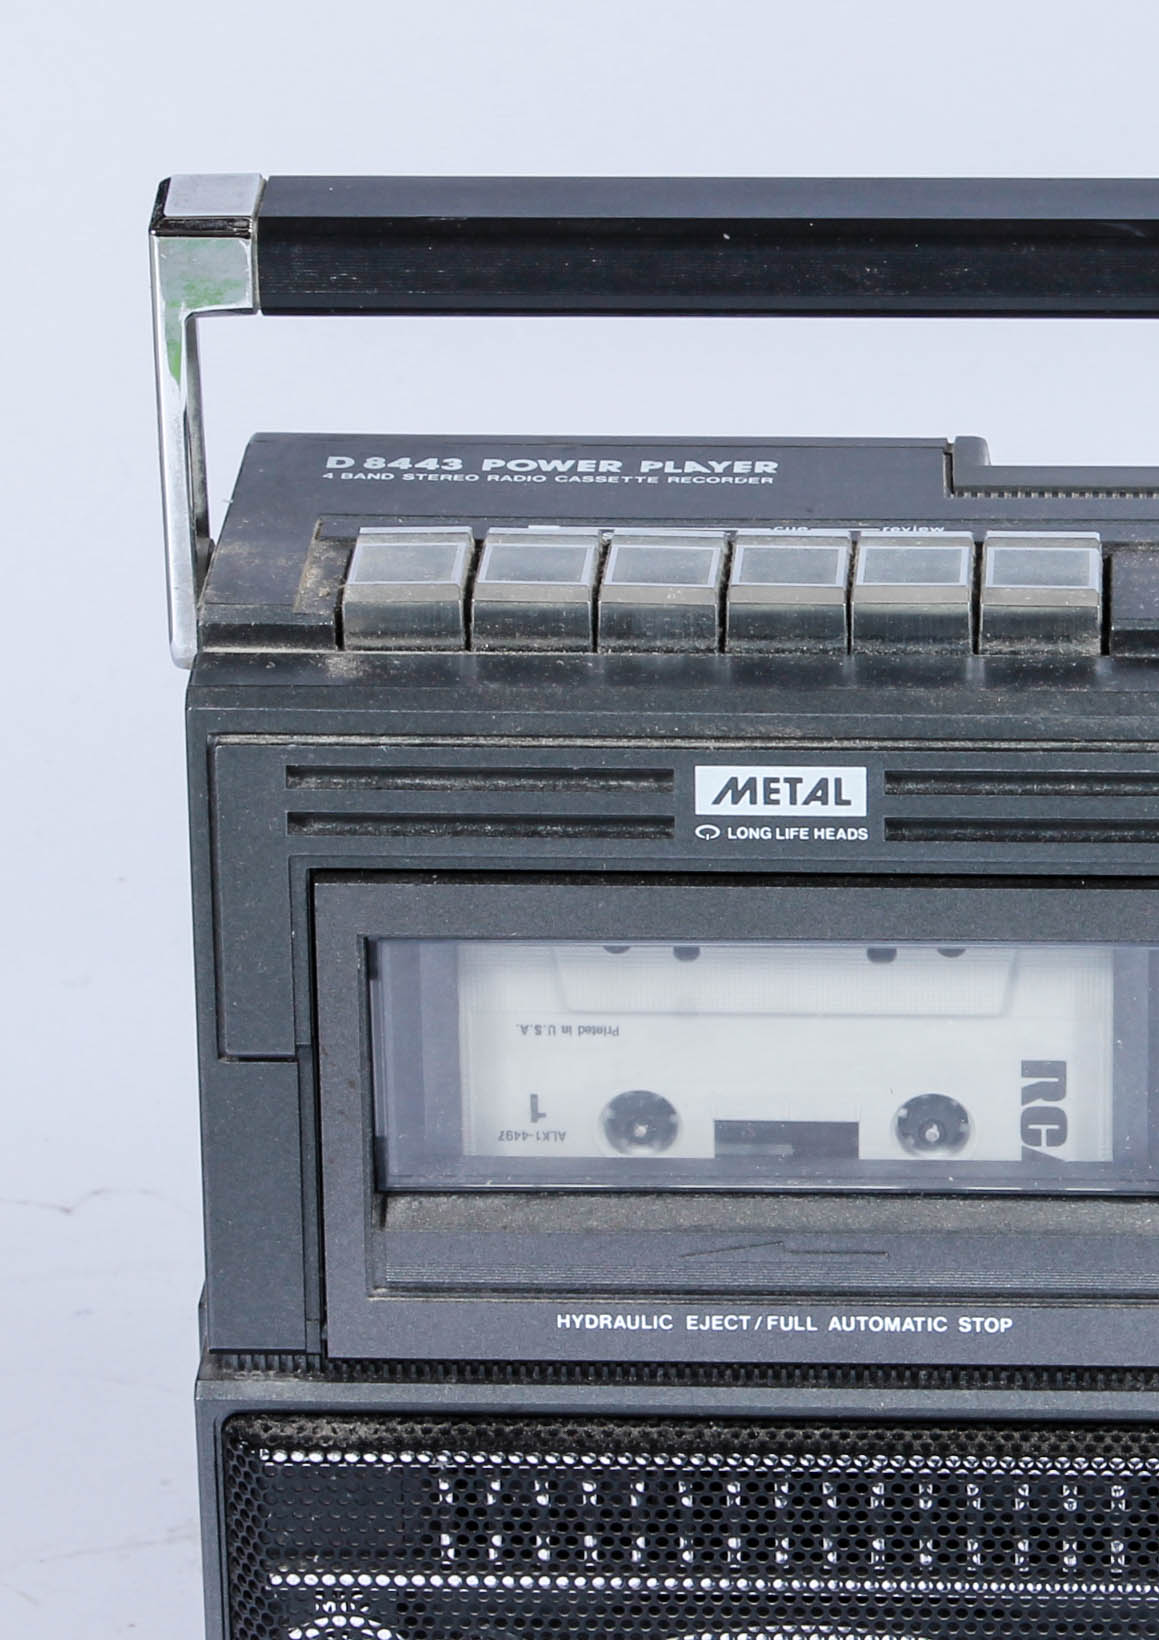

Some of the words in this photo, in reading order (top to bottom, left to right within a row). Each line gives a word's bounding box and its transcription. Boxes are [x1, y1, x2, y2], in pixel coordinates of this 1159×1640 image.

[326, 456, 355, 469] D
[363, 457, 463, 470] 8443
[481, 458, 623, 473] POWER
[640, 460, 779, 473] PLAYER
[322, 472, 334, 480] 4
[341, 472, 395, 481] BAND
[402, 473, 479, 482] STEREO
[487, 474, 547, 483] RADIO
[555, 475, 659, 484] CASSETTE
[667, 476, 774, 485] RECORDER
[712, 776, 852, 806] METAL
[727, 826, 772, 840] LONG
[775, 827, 809, 840] LIFE
[813, 827, 869, 841] HEADS
[515, 1023, 556, 1036] U.S.A.
[561, 1024, 573, 1036] in
[578, 1025, 620, 1037] Printed
[556, 1313, 674, 1331] HYDRAULIC
[828, 1315, 948, 1333] AUTOMATIC
[958, 1316, 1013, 1334] STOP
